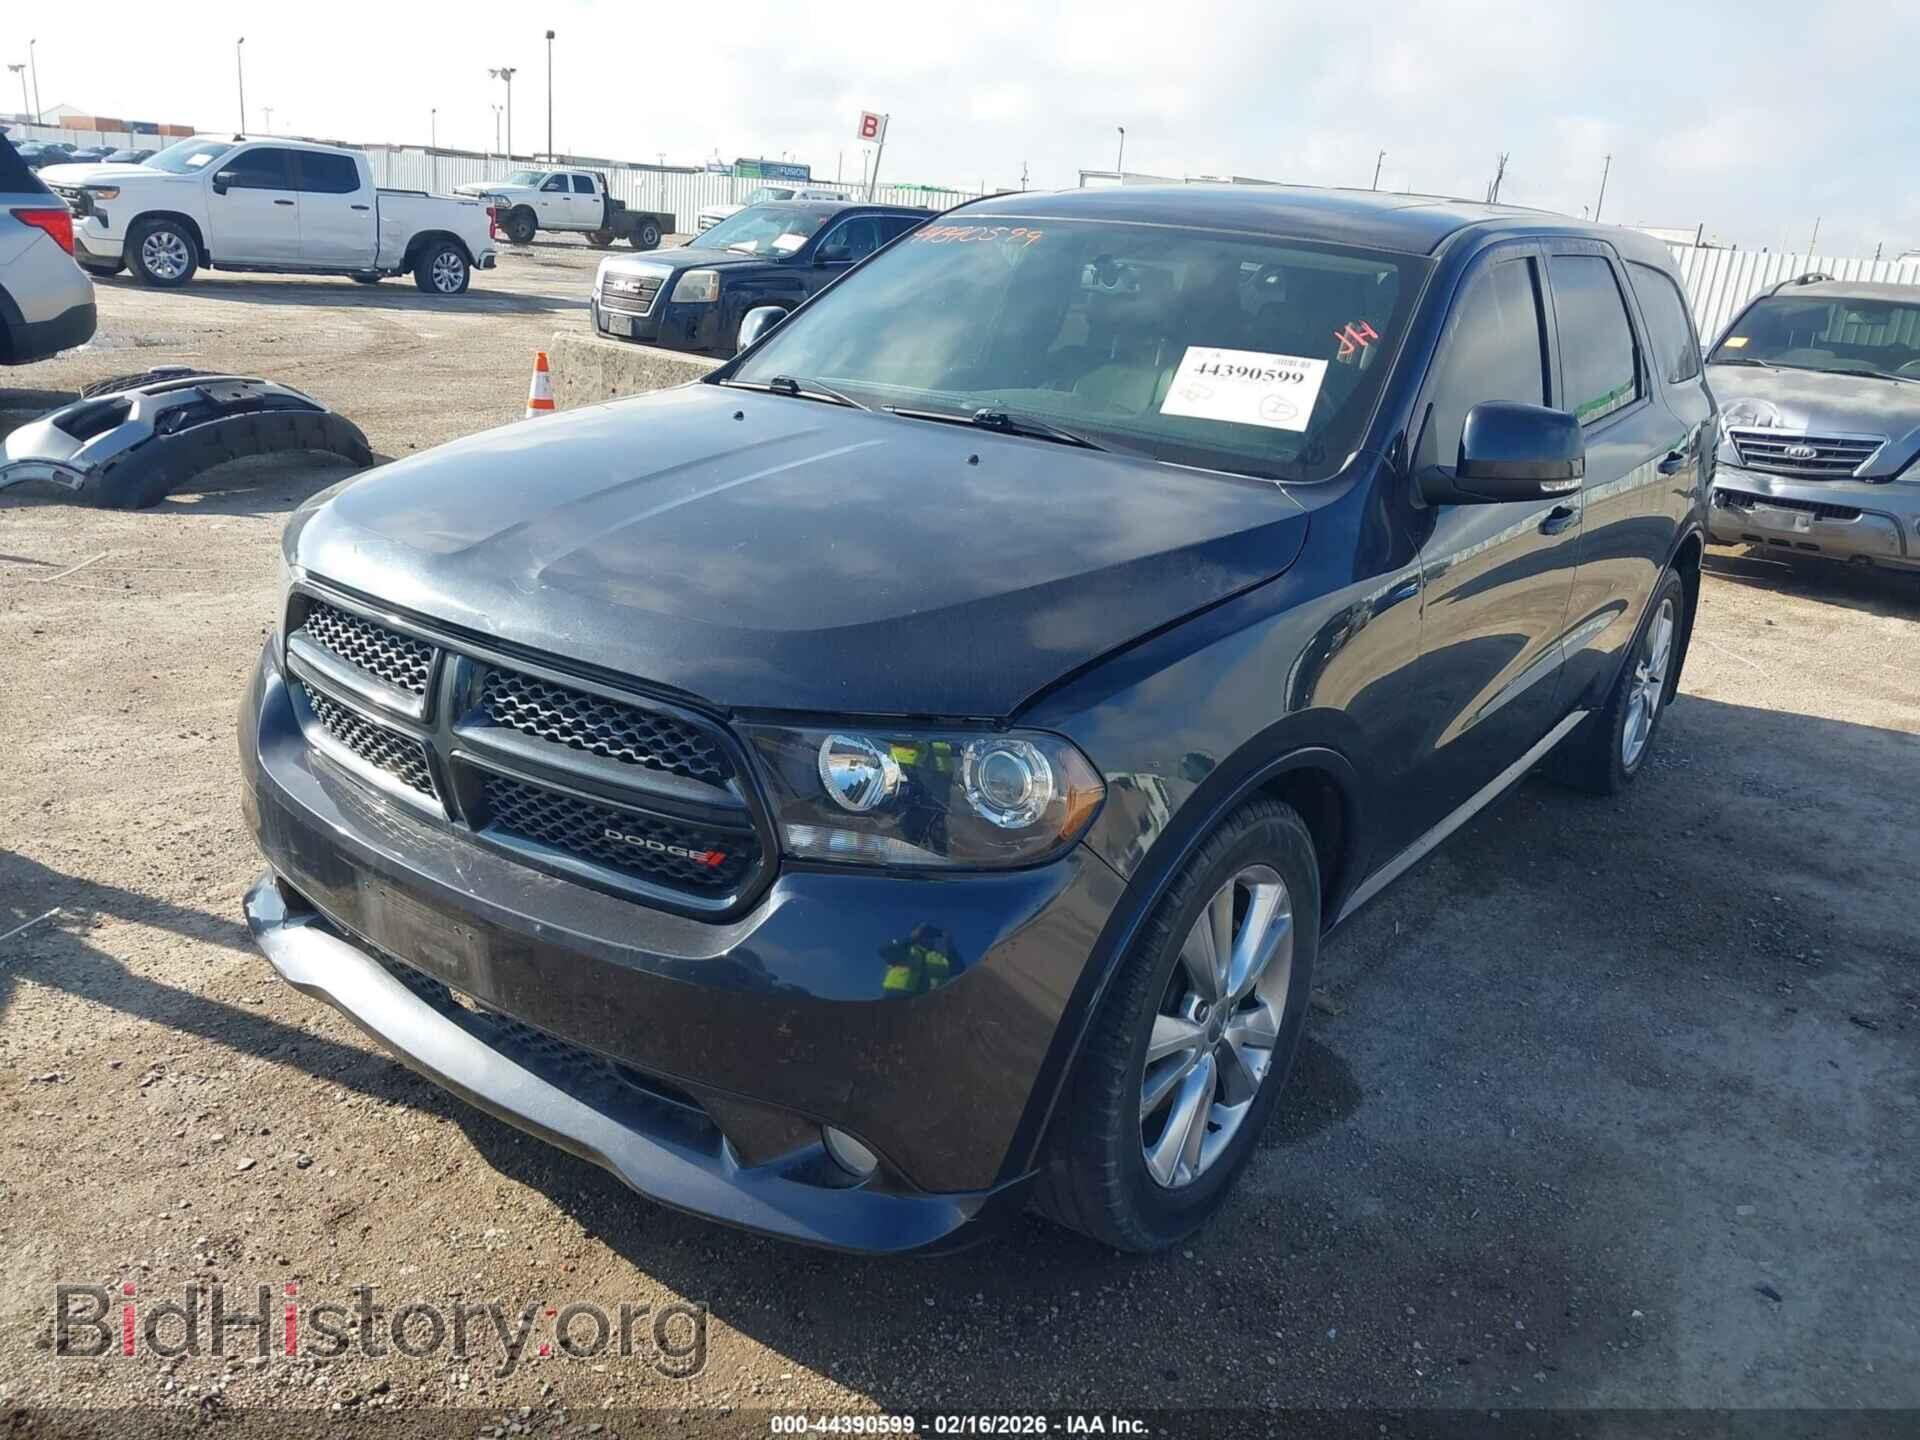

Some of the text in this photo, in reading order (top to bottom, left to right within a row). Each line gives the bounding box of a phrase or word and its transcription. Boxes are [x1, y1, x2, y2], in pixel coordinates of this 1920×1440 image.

[862, 115, 878, 138] B
[613, 279, 641, 293] GMC
[1194, 362, 1305, 385] 44390599
[604, 828, 709, 862] DODGE
